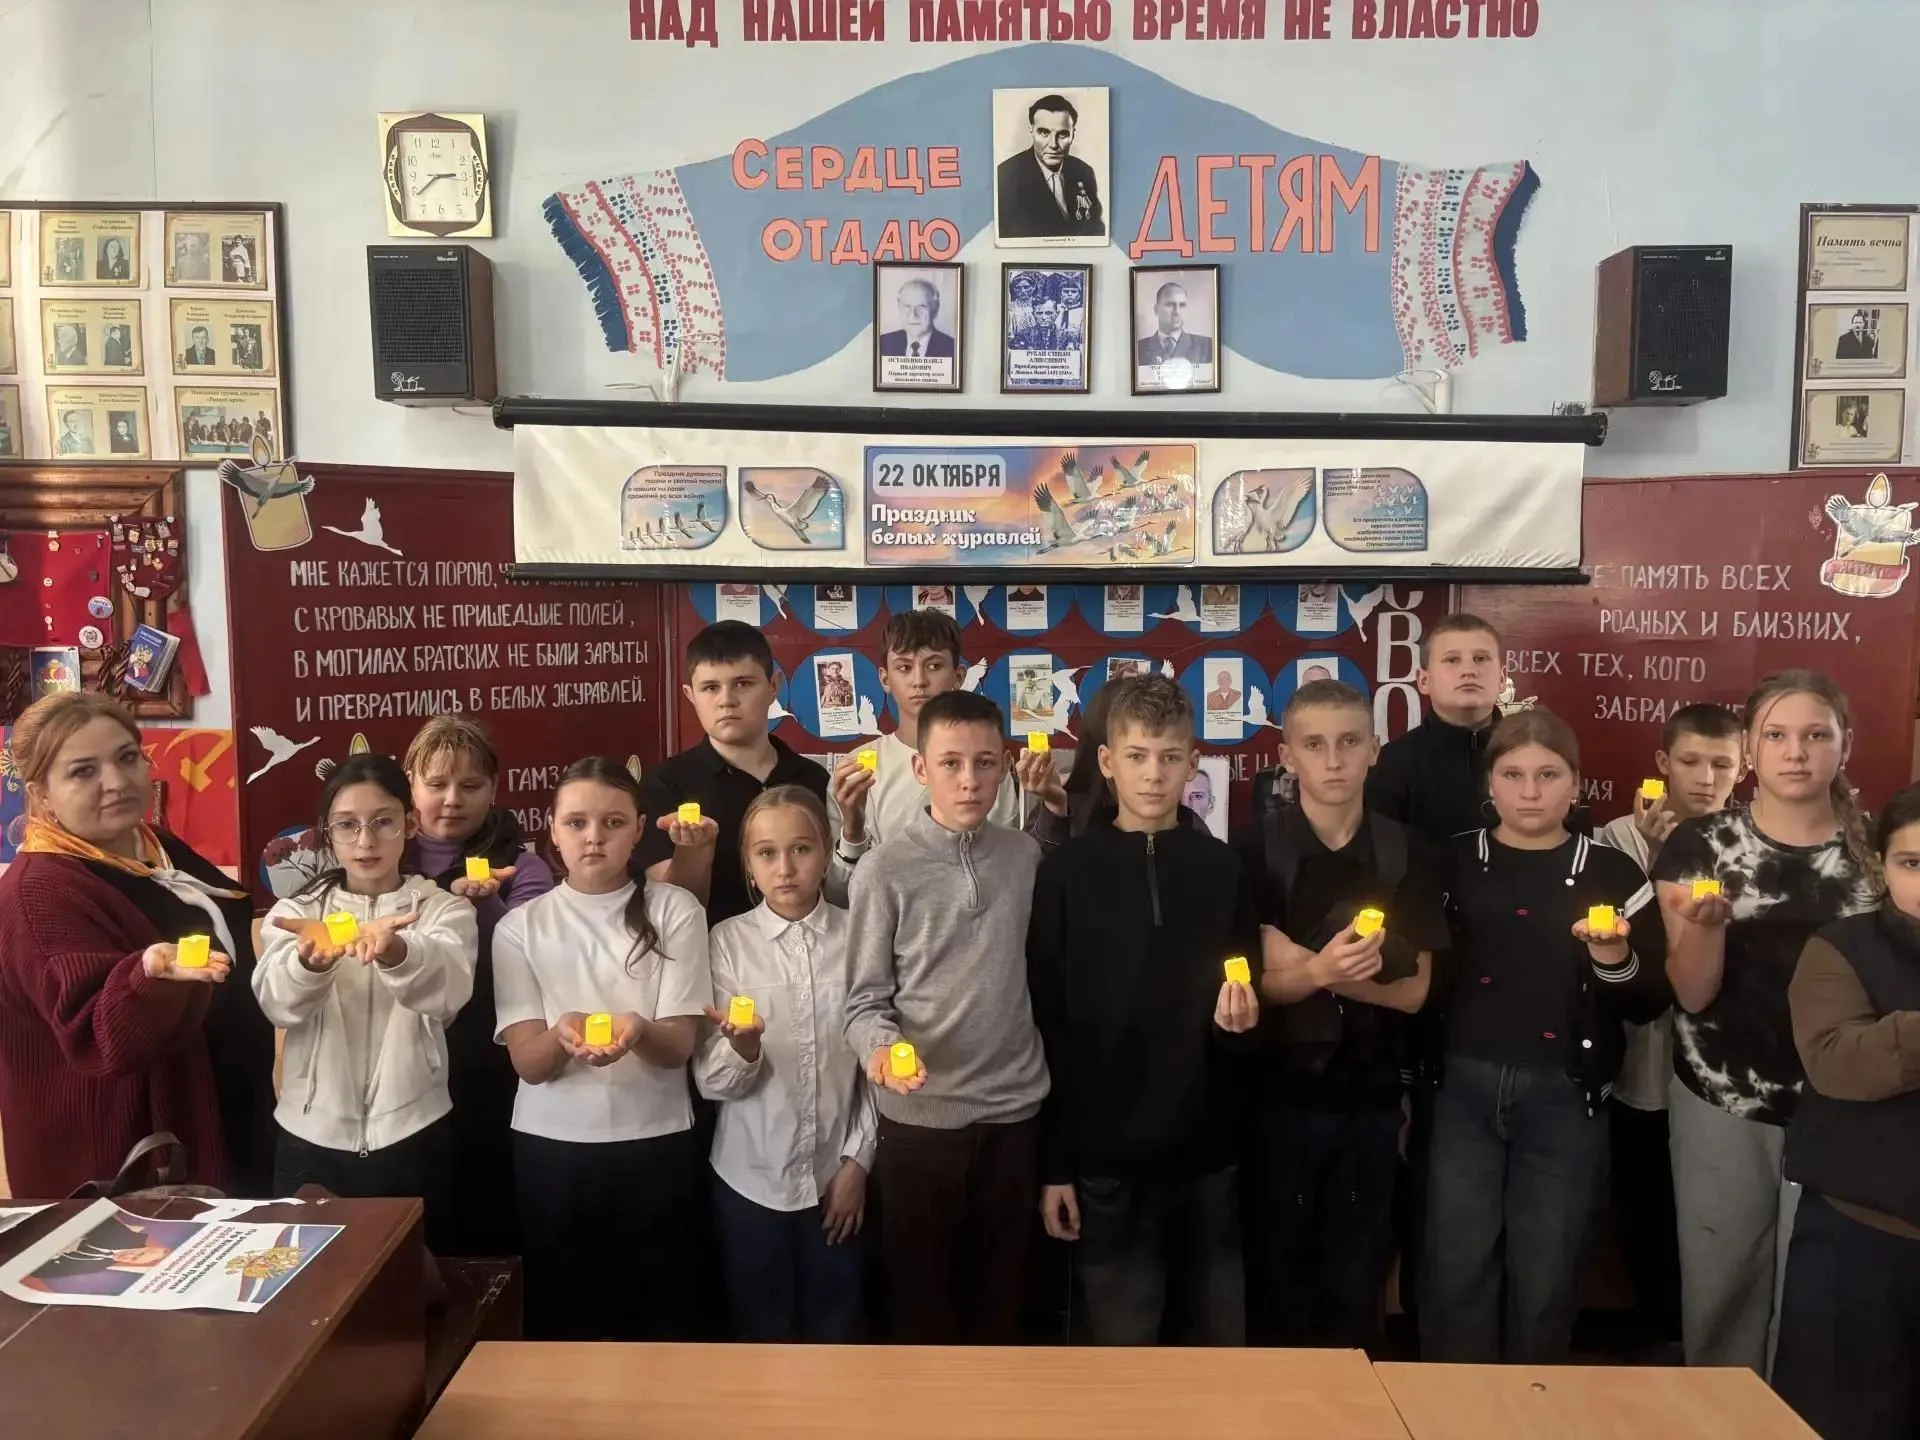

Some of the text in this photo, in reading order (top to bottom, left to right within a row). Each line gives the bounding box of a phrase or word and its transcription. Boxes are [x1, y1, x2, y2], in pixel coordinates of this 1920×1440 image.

[629, 0, 1540, 48] НАД НАШЕЙ ПАМЯТЬЮ ВРЕМЯ НЕ ВЛАСТНО
[732, 138, 961, 195] СЕРДЦЕ
[1128, 154, 1381, 260] ДЕТЯМ
[762, 218, 960, 265] ОТДАЮ
[1816, 236, 1902, 247] Память вечна
[878, 463, 1000, 487] 22 ОКТЯБРЯ
[871, 503, 976, 525] Праздник
[871, 527, 1042, 550] белых журавлей
[290, 560, 329, 587] МНЕ
[338, 559, 429, 587] КАЖЕТСЯ
[435, 560, 498, 590] ПОРОЮ,
[1621, 564, 1710, 591] ПАМЯТЬ
[1722, 565, 1792, 592] ВСЕХ
[294, 607, 310, 633] С
[315, 605, 417, 632] КРОВАВЫХ
[423, 605, 446, 629] НЕ
[452, 603, 562, 628] ПРИШЕДШИЕ
[1600, 609, 1861, 643] РОДНЫХ И БЛИЗКИХ,
[294, 640, 649, 678] В МОГИЛАХ БРАТСКИХ НЕ БЫЛИ ЗАРЫТЫ
[1505, 650, 1706, 683] ВСЕХ ТЕХ, КОГО
[296, 675, 647, 723] И ПРЕВРАТИЛИСЬ В БЕЛЫХ ЖУРАВЛЕЙ.
[508, 765, 568, 792] ГАМЗ
